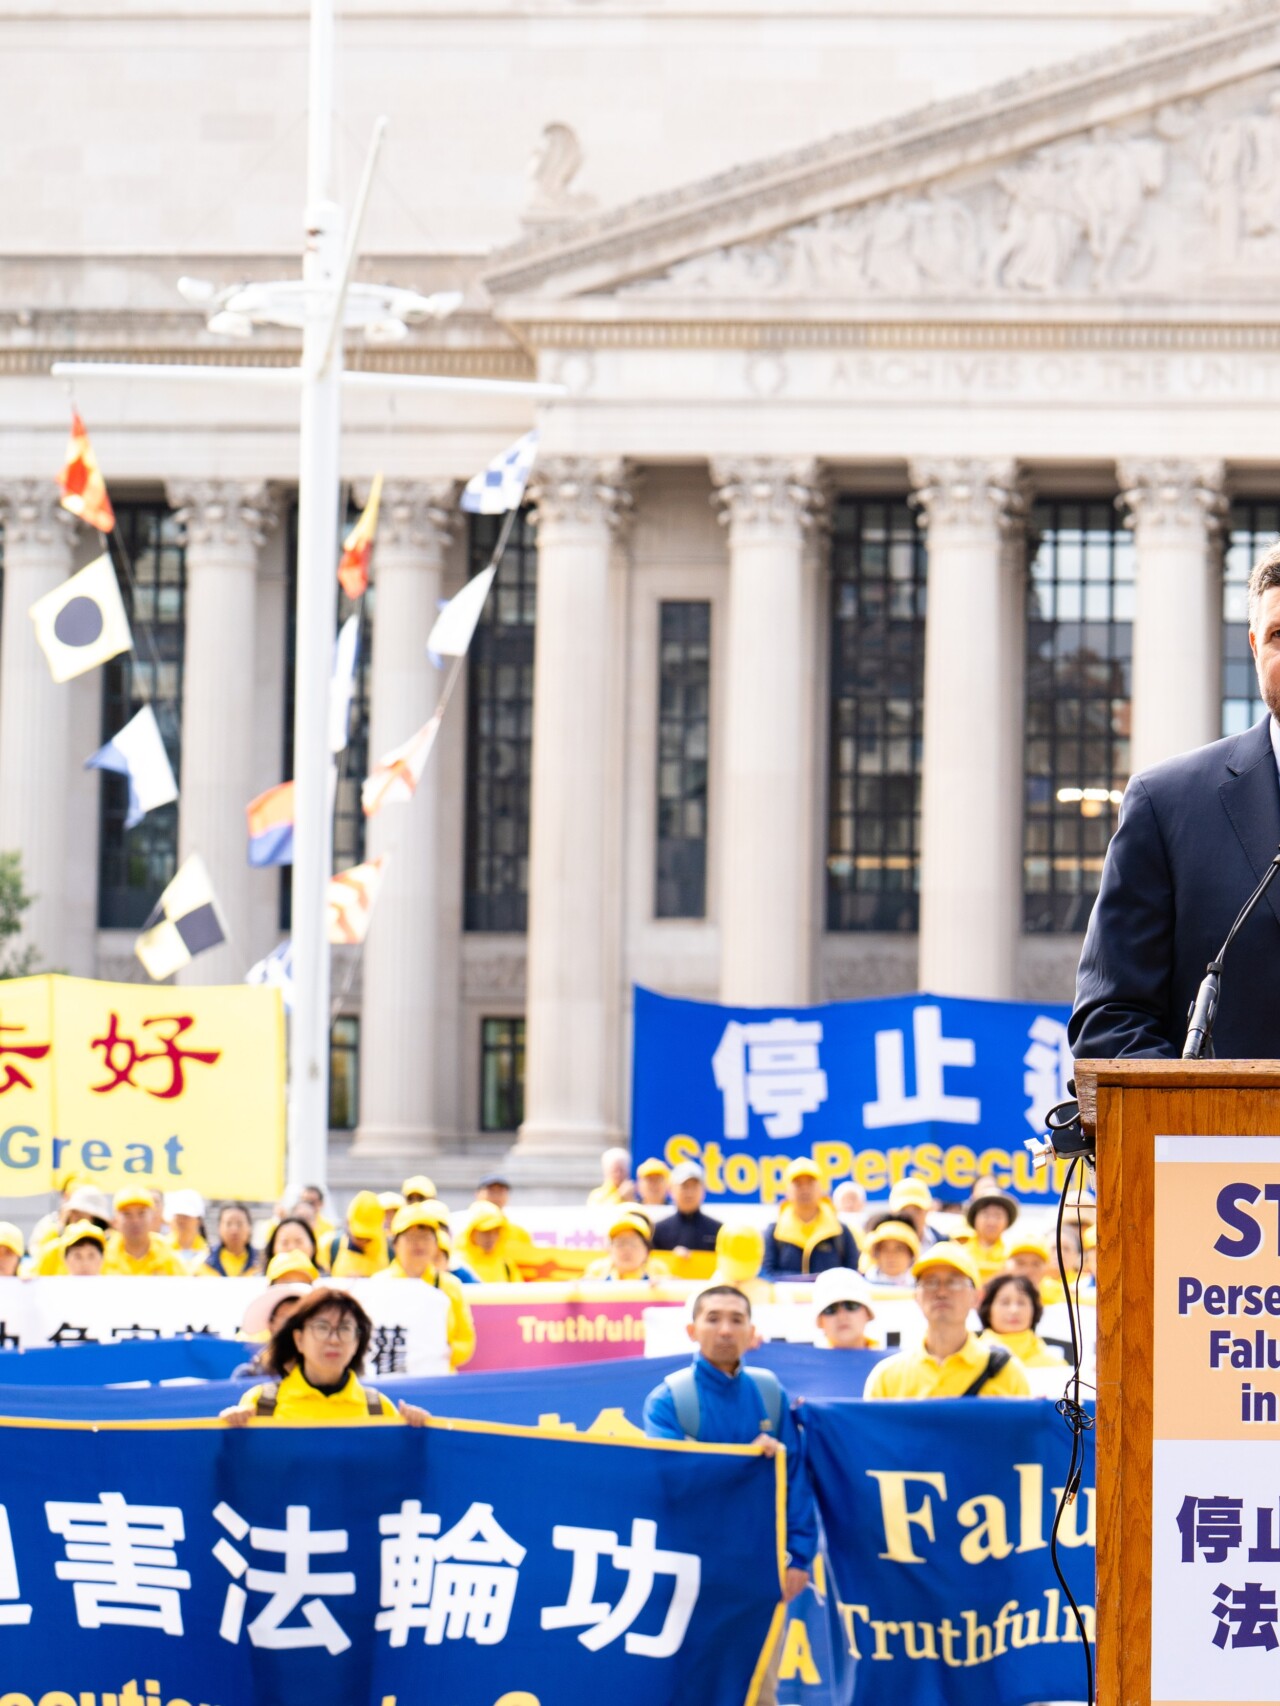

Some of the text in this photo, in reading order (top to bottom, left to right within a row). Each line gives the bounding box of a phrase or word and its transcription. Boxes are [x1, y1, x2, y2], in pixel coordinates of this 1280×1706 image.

[829, 357, 1019, 391] ARCHIVES
[1035, 357, 1086, 391] OF
[1098, 357, 1168, 391] THE
[0, 1125, 185, 1176] Great
[665, 1134, 797, 1203] Stop
[1242, 1383, 1276, 1422] in
